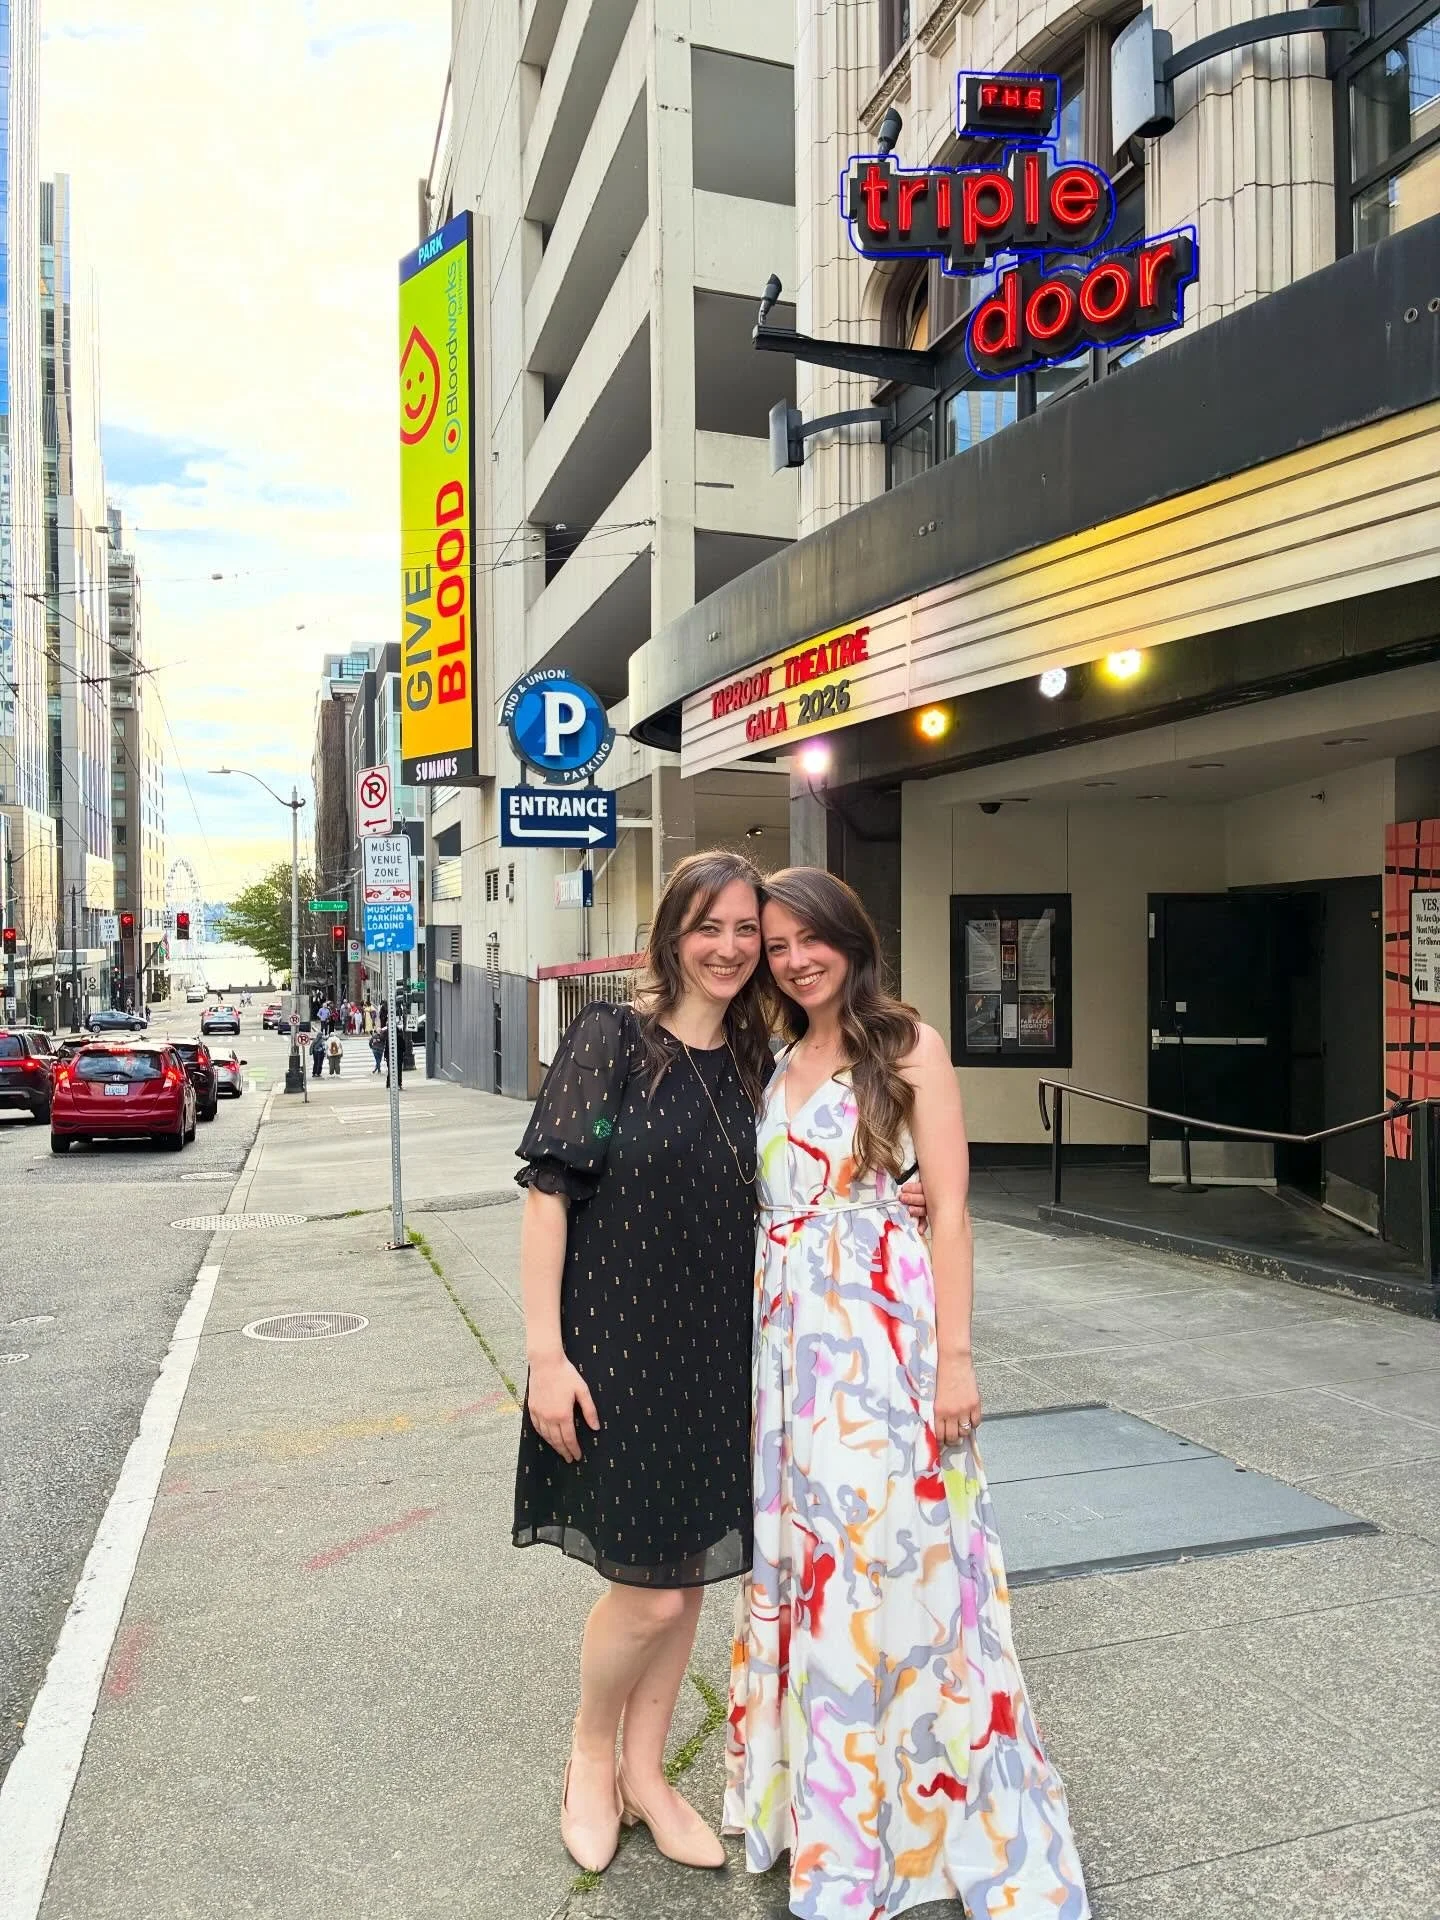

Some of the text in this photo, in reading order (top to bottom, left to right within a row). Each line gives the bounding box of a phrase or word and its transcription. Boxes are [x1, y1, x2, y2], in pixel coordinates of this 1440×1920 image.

[981, 86, 1043, 111] THE
[861, 155, 1099, 246] triple
[418, 232, 443, 265] PARK
[973, 243, 1173, 355] door
[446, 261, 458, 417] Bloodworks
[436, 480, 466, 704] BLOOD
[405, 563, 433, 712] GIVE
[711, 626, 870, 720] TAPROOT THEATRE
[504, 669, 566, 718] 2ND & UNION
[745, 679, 850, 743] GALA 2026
[541, 691, 586, 756] P
[415, 756, 458, 782] SUMMUS
[563, 742, 610, 781] PARKING
[509, 795, 608, 817] ENTRANCE
[371, 842, 401, 852] MUSIC
[371, 855, 402, 864] VENUE
[374, 868, 399, 877] ZONE
[367, 913, 413, 922] PARKING &
[1421, 898, 1440, 912] YES,
[367, 922, 404, 931] LOADING
